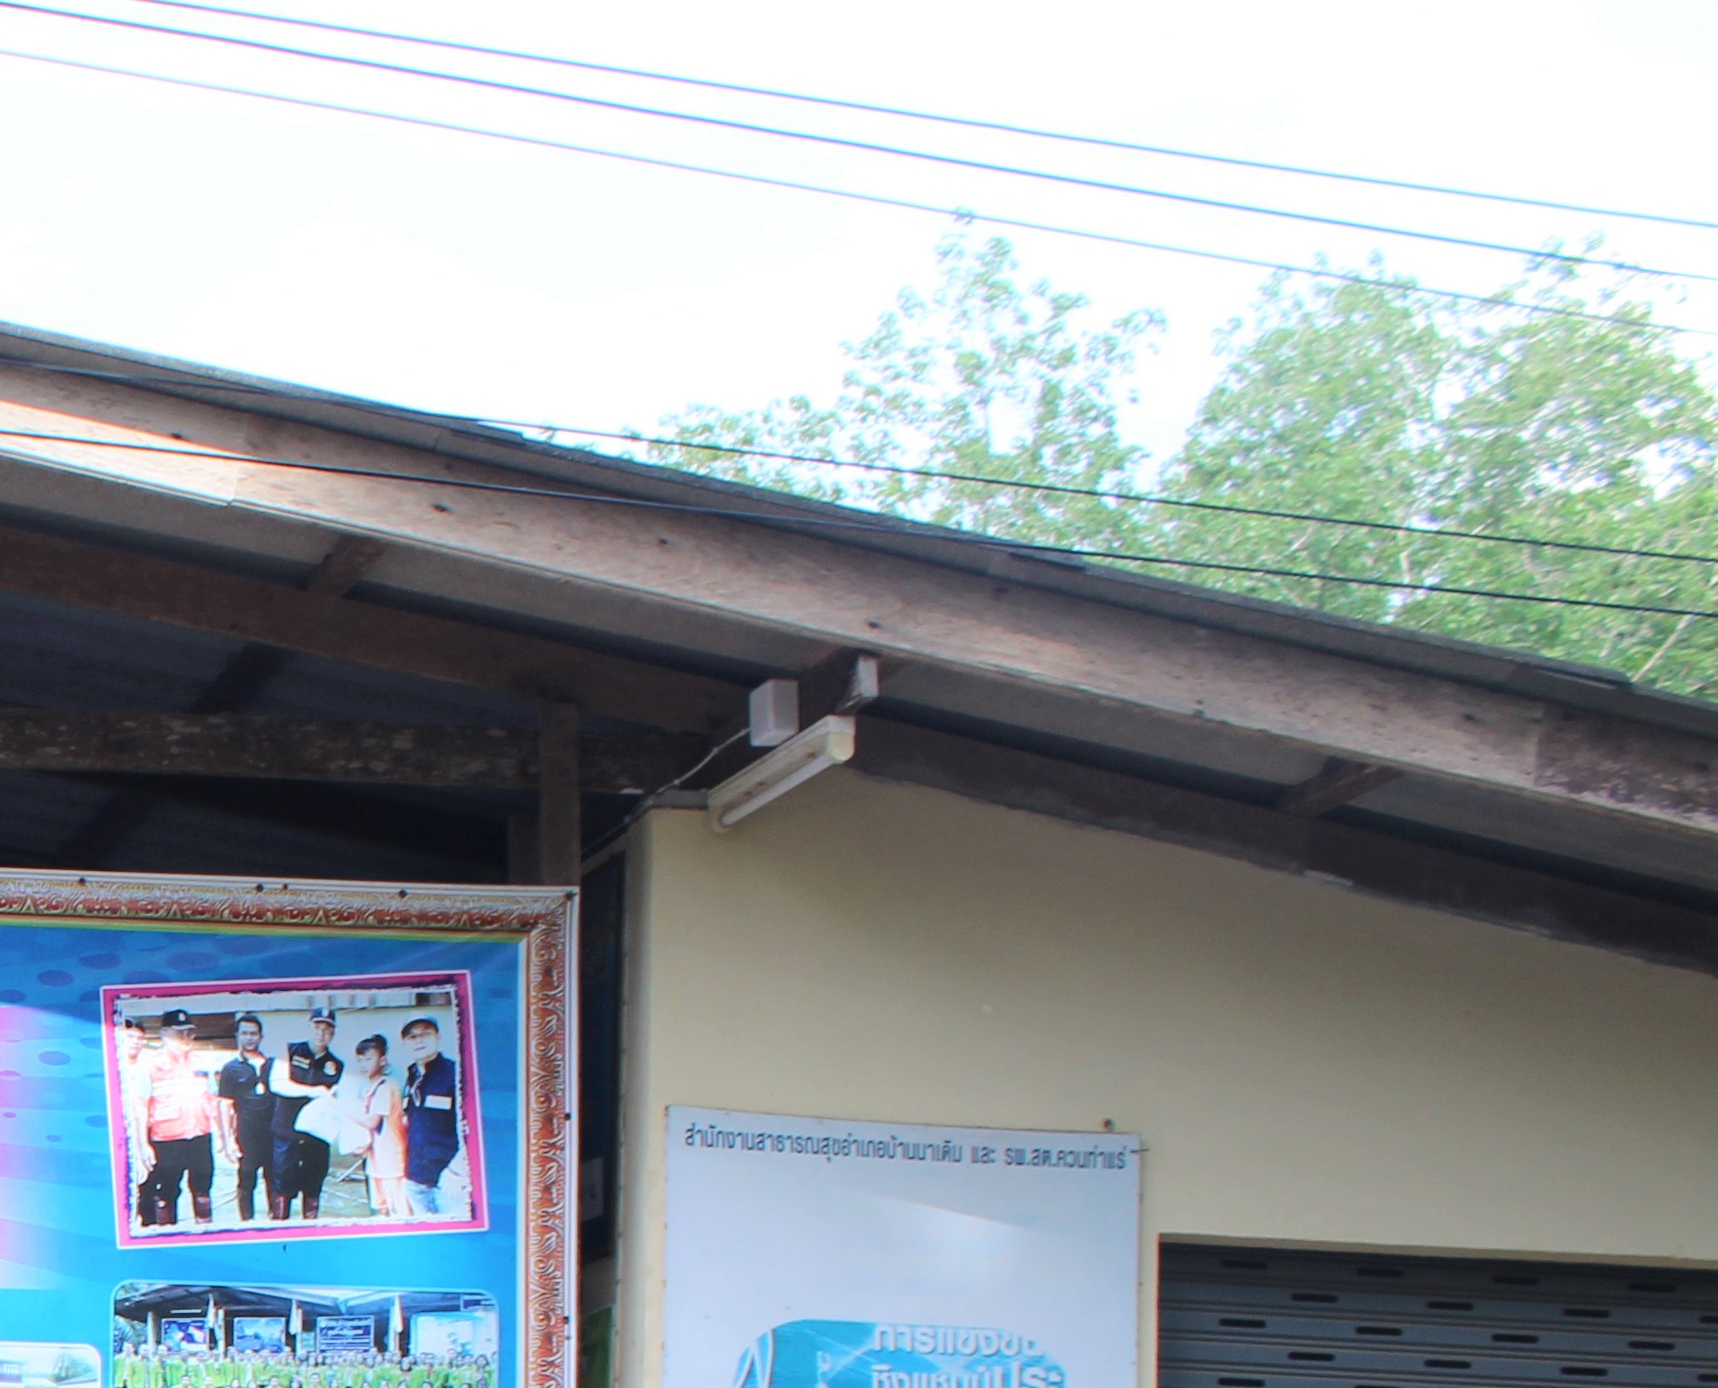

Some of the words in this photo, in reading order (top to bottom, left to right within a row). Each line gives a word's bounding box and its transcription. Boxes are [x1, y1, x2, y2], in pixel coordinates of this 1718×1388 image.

[684, 1122, 963, 1164] สำนักงานสาธารณสุขอำเภอบ้านนาเดิม
[970, 1146, 997, 1165] และ
